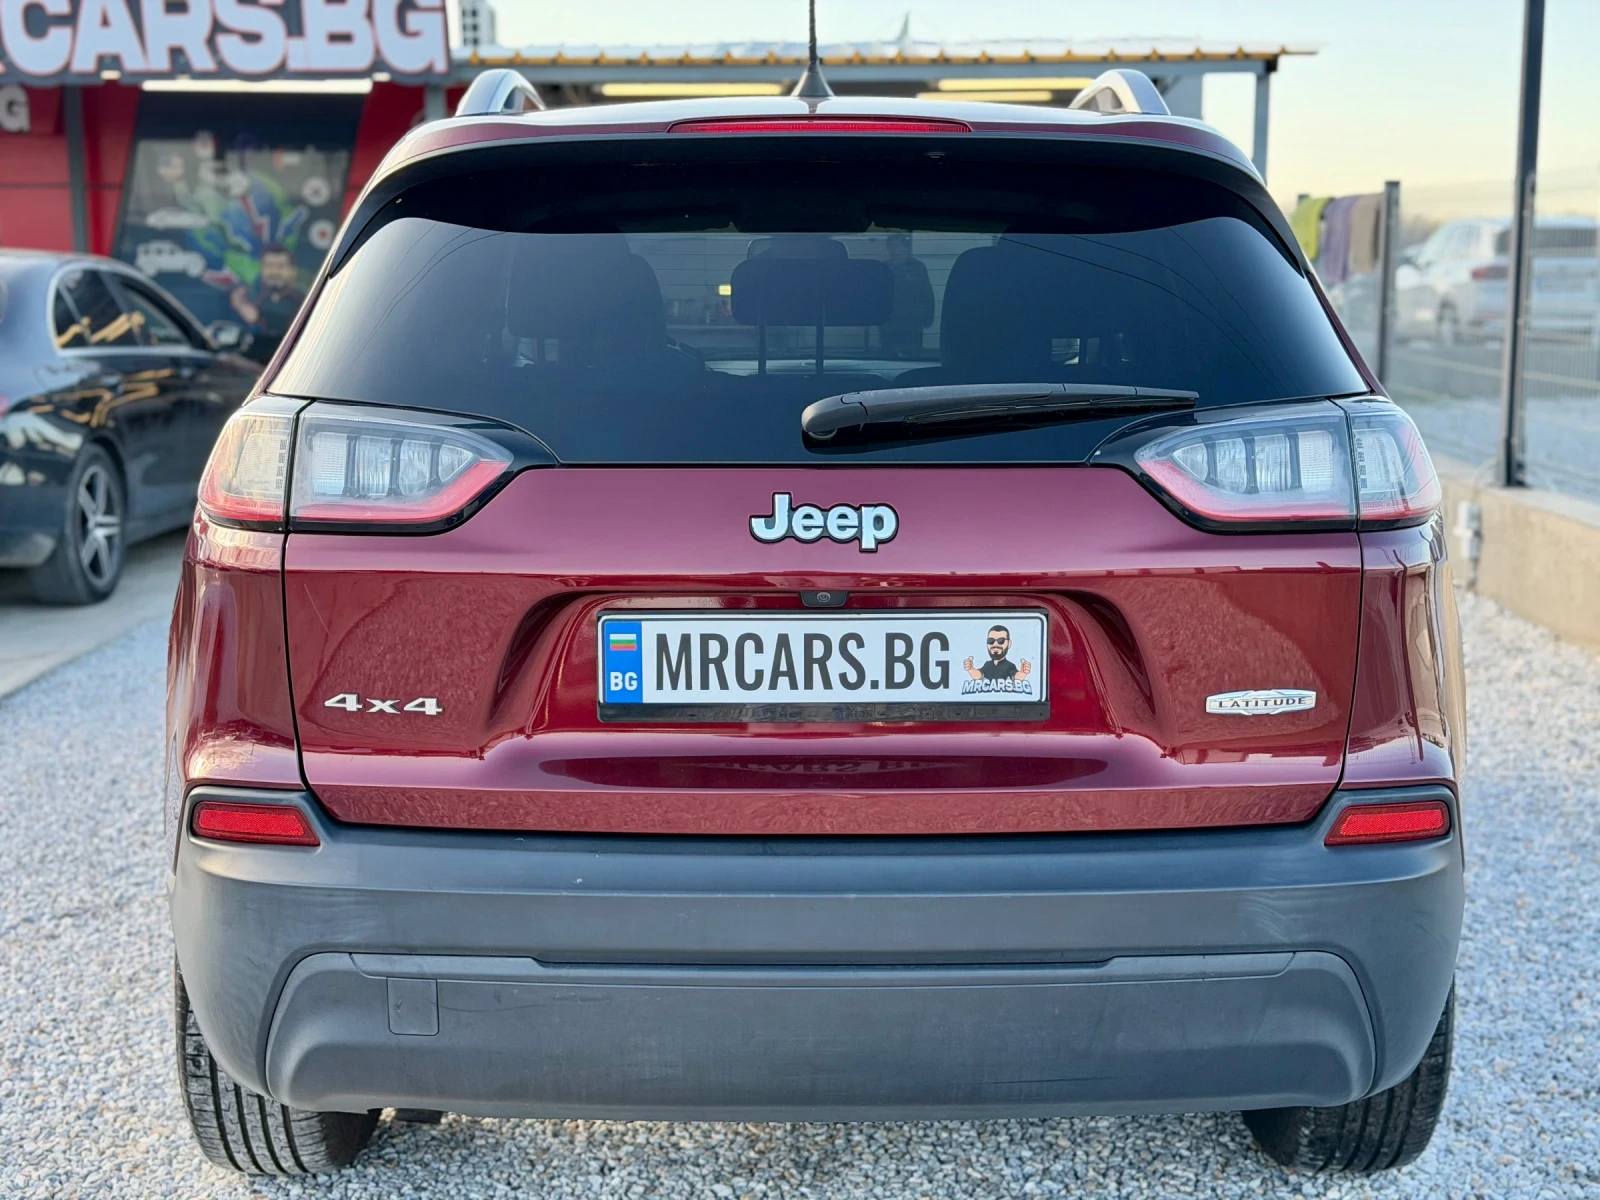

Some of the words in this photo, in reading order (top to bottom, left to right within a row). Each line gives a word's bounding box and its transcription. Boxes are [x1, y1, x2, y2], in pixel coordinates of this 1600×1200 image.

[0, 0, 448, 75] CARS.BG
[750, 492, 899, 551] Jeep
[655, 631, 951, 691] MRCARS.BG
[610, 671, 638, 691] BG
[961, 676, 1033, 695] MRCARS.BG
[324, 693, 443, 715] 4x4
[1218, 697, 1307, 708] LATITUDE
